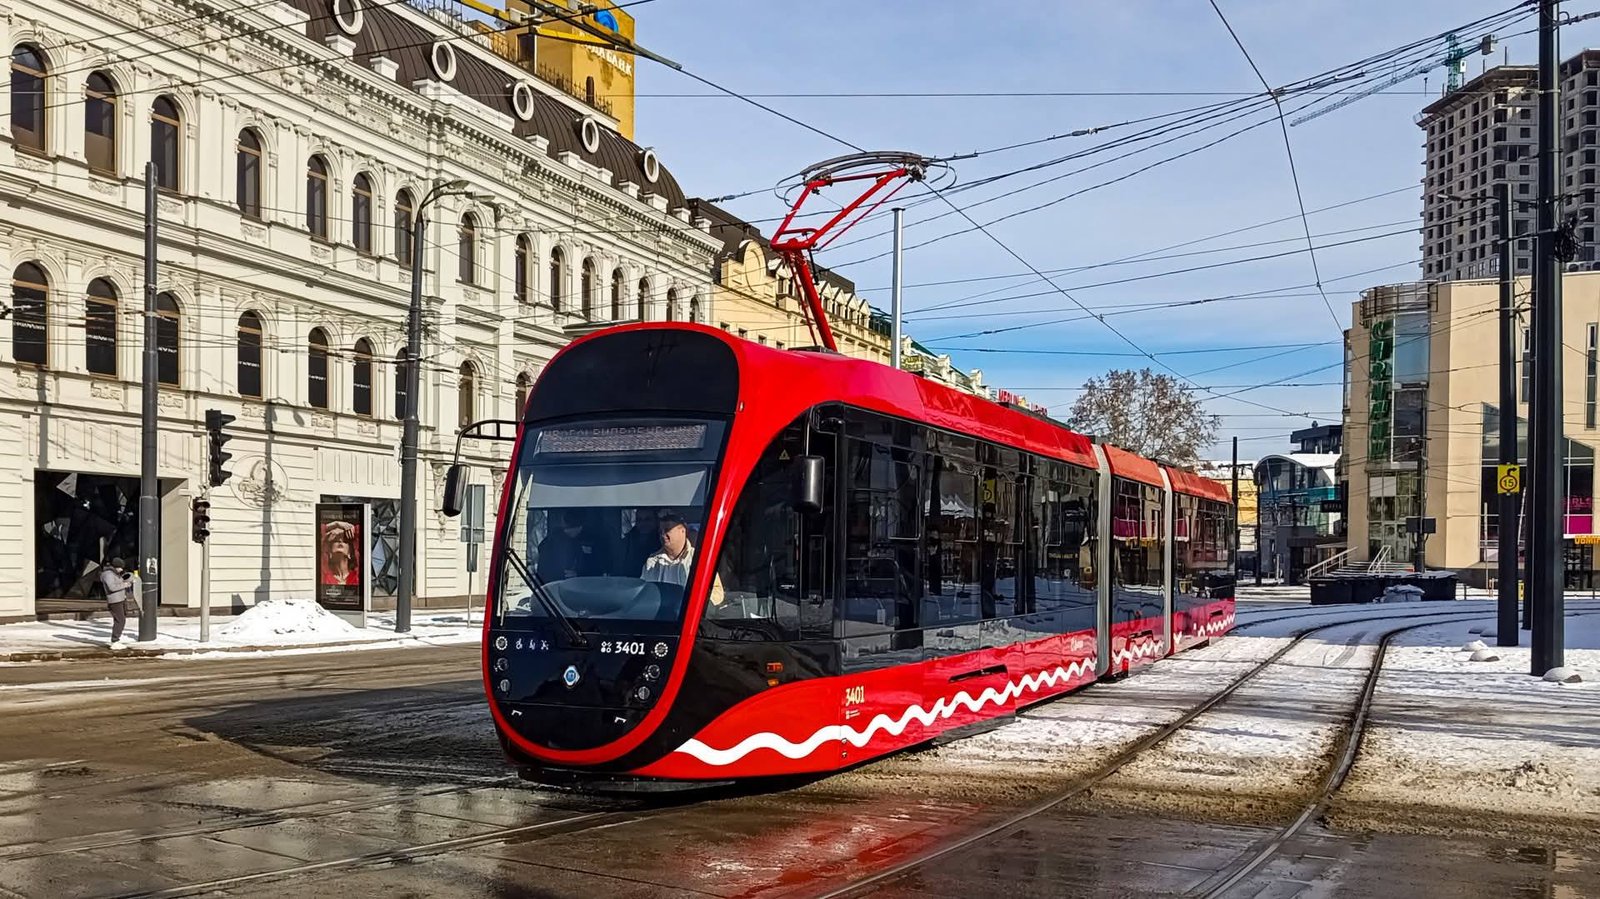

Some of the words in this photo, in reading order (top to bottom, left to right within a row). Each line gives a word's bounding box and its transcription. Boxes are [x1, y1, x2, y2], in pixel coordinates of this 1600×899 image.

[1503, 479, 1514, 487] 15
[614, 641, 646, 655] 3401
[845, 685, 865, 706] 3401
